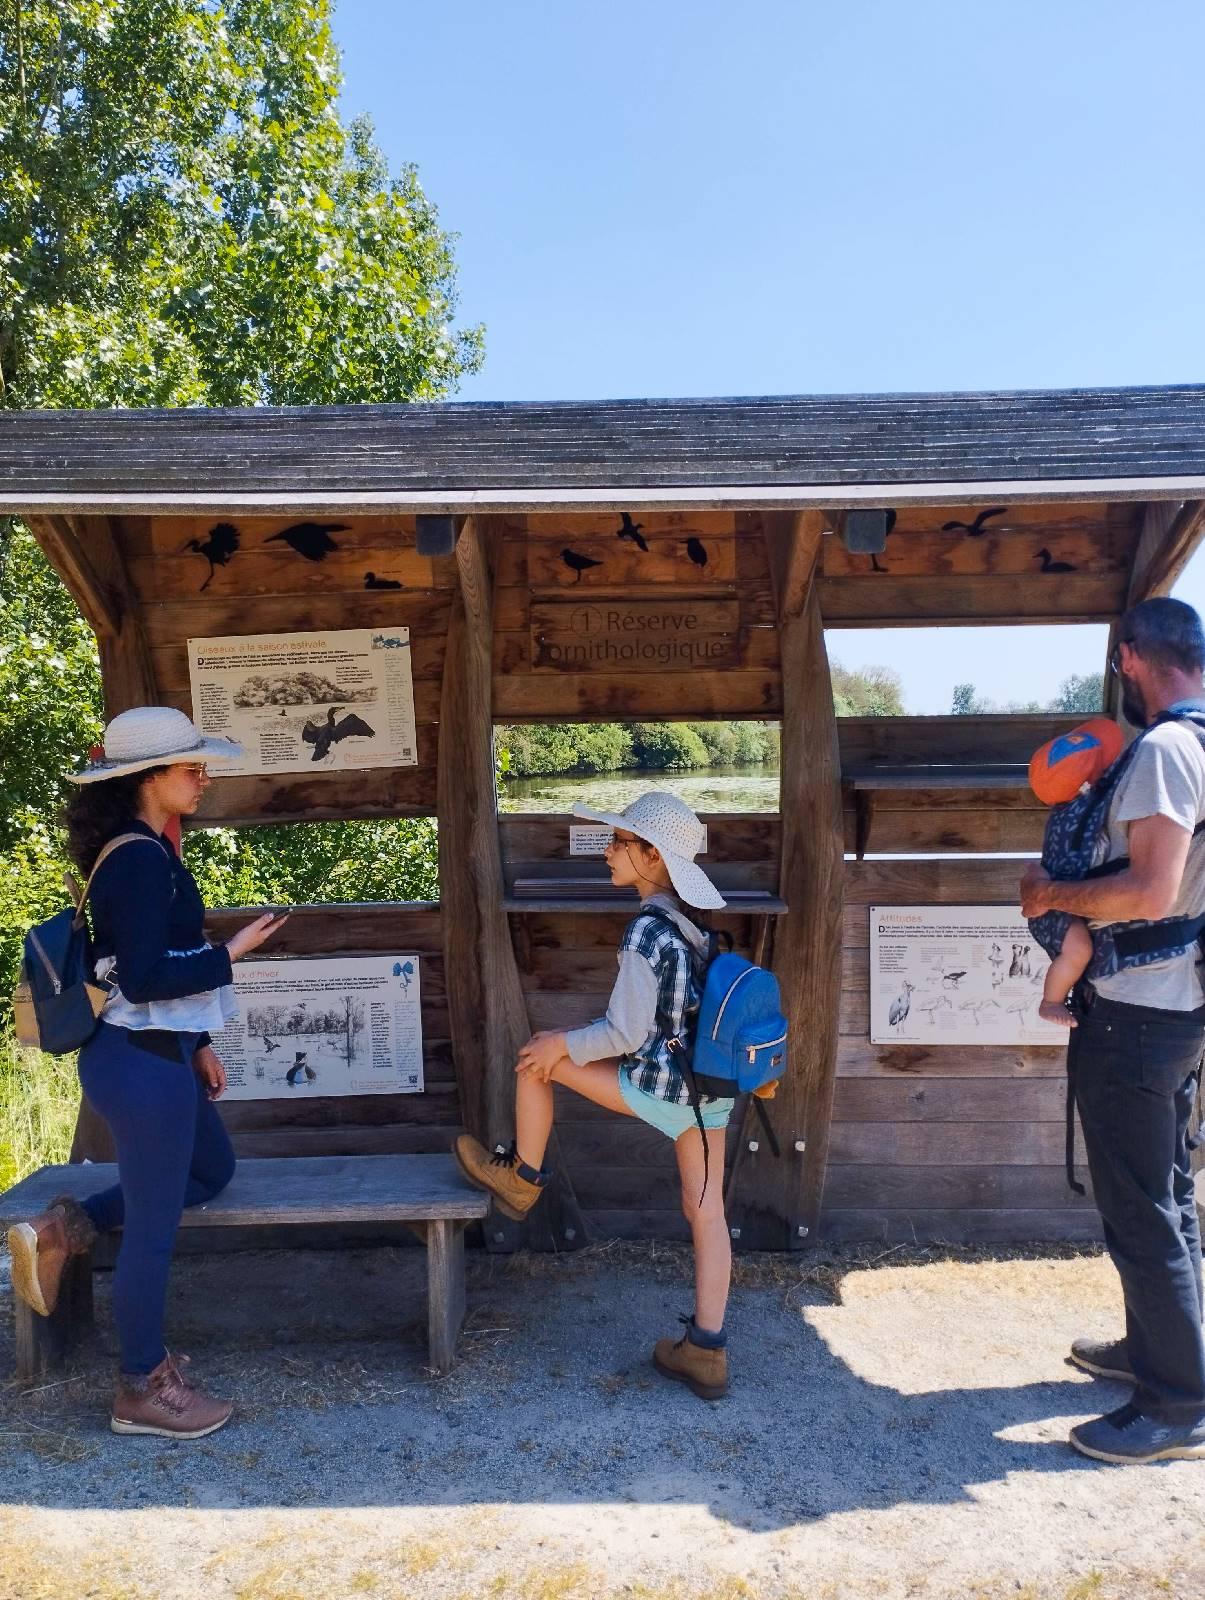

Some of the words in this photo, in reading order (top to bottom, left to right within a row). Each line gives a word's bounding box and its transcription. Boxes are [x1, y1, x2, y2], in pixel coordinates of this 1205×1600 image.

[582, 611, 590, 631] 1
[607, 610, 698, 631] Réserve
[247, 642, 255, 652] la
[258, 640, 289, 652] saison
[290, 639, 326, 650] estivale
[549, 638, 724, 665] ornithologique
[879, 914, 923, 923] Attitudes
[249, 970, 280, 979] d'hiver
